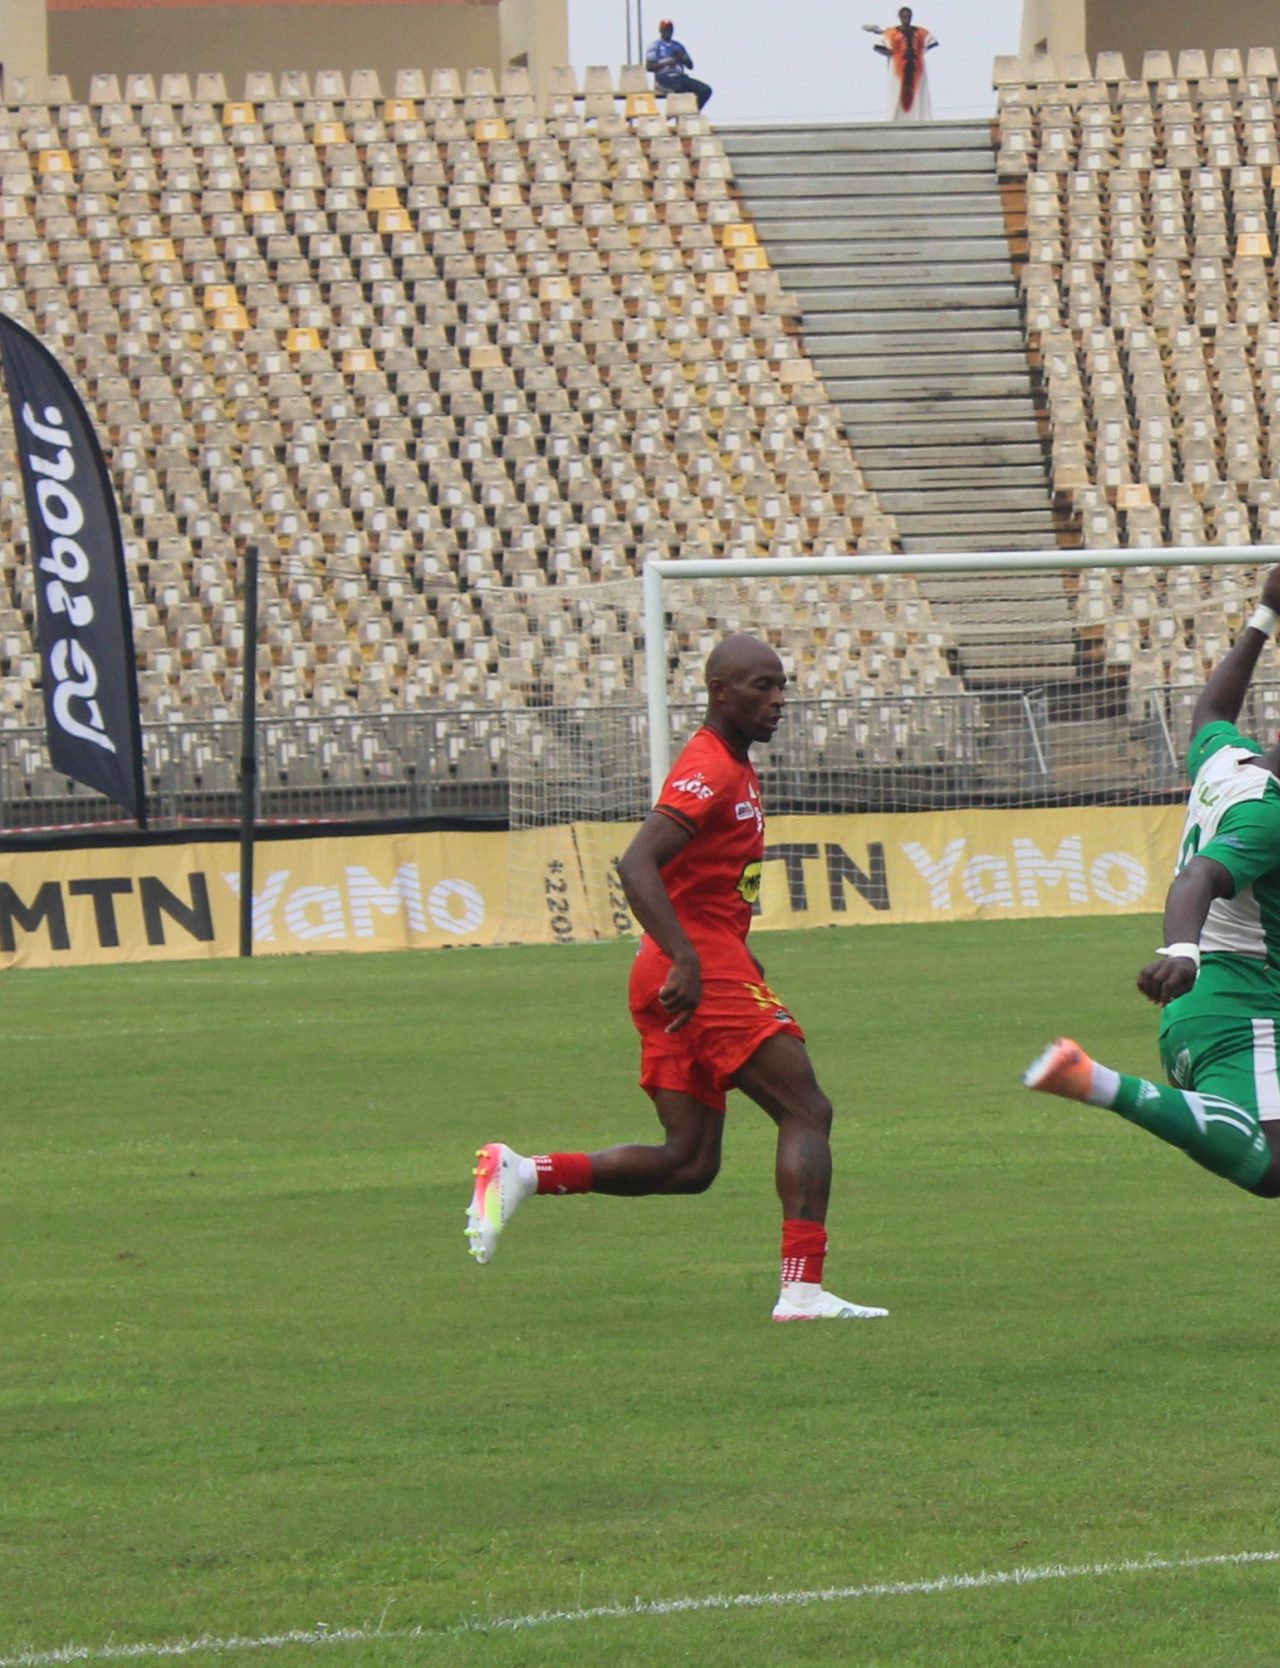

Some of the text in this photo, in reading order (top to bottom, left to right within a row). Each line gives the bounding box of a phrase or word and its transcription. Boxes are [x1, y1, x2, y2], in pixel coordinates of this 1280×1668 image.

[0, 861, 485, 953] MTN YaMo
[902, 835, 1148, 910] YaMo
